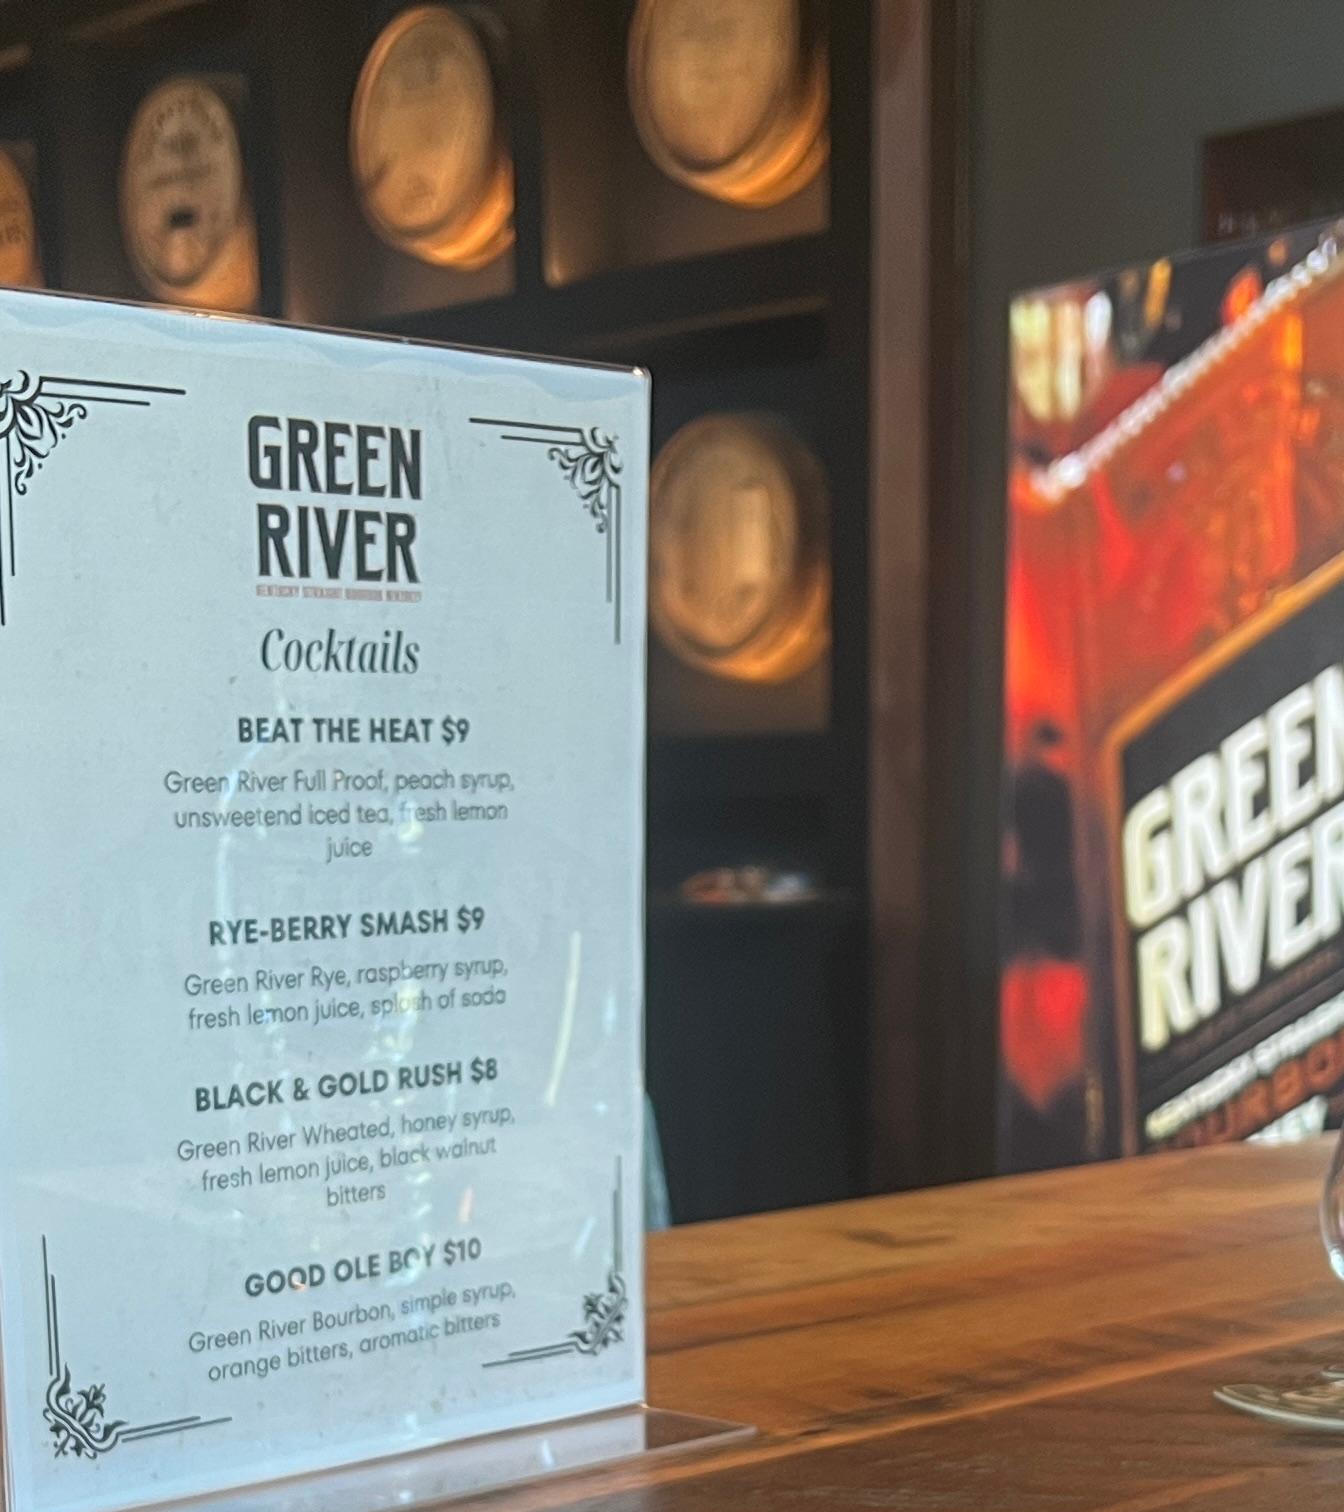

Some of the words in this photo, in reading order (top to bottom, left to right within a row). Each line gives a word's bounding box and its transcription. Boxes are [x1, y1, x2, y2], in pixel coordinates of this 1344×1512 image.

[248, 415, 422, 500] GREEN
[257, 503, 420, 583] RIVER
[261, 628, 419, 675] Cocktails
[238, 717, 304, 743] BEAT
[312, 717, 361, 743] THE
[369, 717, 433, 743] HEAT
[441, 715, 471, 746] $9
[164, 770, 230, 794] Green
[238, 770, 288, 792] River
[293, 769, 326, 792] Full
[334, 769, 389, 794] Proof,
[395, 768, 455, 797] peach
[461, 771, 515, 795] syrup,
[174, 803, 302, 828] unsweetend
[308, 802, 350, 825] iced
[356, 803, 393, 826] tea,
[452, 800, 509, 821] lemon
[326, 839, 373, 864] juice
[209, 914, 352, 946] RYE-BERRY
[360, 909, 449, 938] SMASH
[456, 904, 485, 933] $9
[185, 972, 249, 996] Green
[256, 968, 304, 991] River
[311, 965, 351, 992] Rye,
[357, 959, 449, 988] raspberry
[189, 1007, 241, 1030] fresh
[248, 1002, 308, 1025] lemon
[314, 998, 364, 1025] juice,
[438, 989, 456, 1010] of
[461, 986, 506, 1006] soda
[195, 1080, 284, 1112] BLACK
[293, 1077, 309, 1101] &
[318, 1070, 389, 1098] GOLD
[398, 1061, 462, 1089] RUSH
[470, 1056, 498, 1086] $8
[177, 1139, 241, 1161] Green
[248, 1131, 296, 1153] River
[303, 1117, 395, 1145] Wheated,
[401, 1112, 457, 1137] honey
[202, 1169, 252, 1192] fresh
[259, 1161, 320, 1185] lemon
[325, 1154, 374, 1181] juice,
[380, 1145, 431, 1168] black
[436, 1137, 497, 1160] walnut
[326, 1182, 386, 1207] bitters
[245, 1264, 326, 1297] GOOD
[333, 1253, 381, 1282] OLE
[443, 1237, 482, 1266] $10
[188, 1327, 251, 1353] Green
[258, 1318, 306, 1342] River
[313, 1303, 396, 1332] Bourbon,
[401, 1291, 457, 1316] simple
[208, 1355, 281, 1382] orange
[287, 1339, 354, 1369] bitters,
[359, 1323, 440, 1353] aromatic
[444, 1311, 501, 1337] bitters
